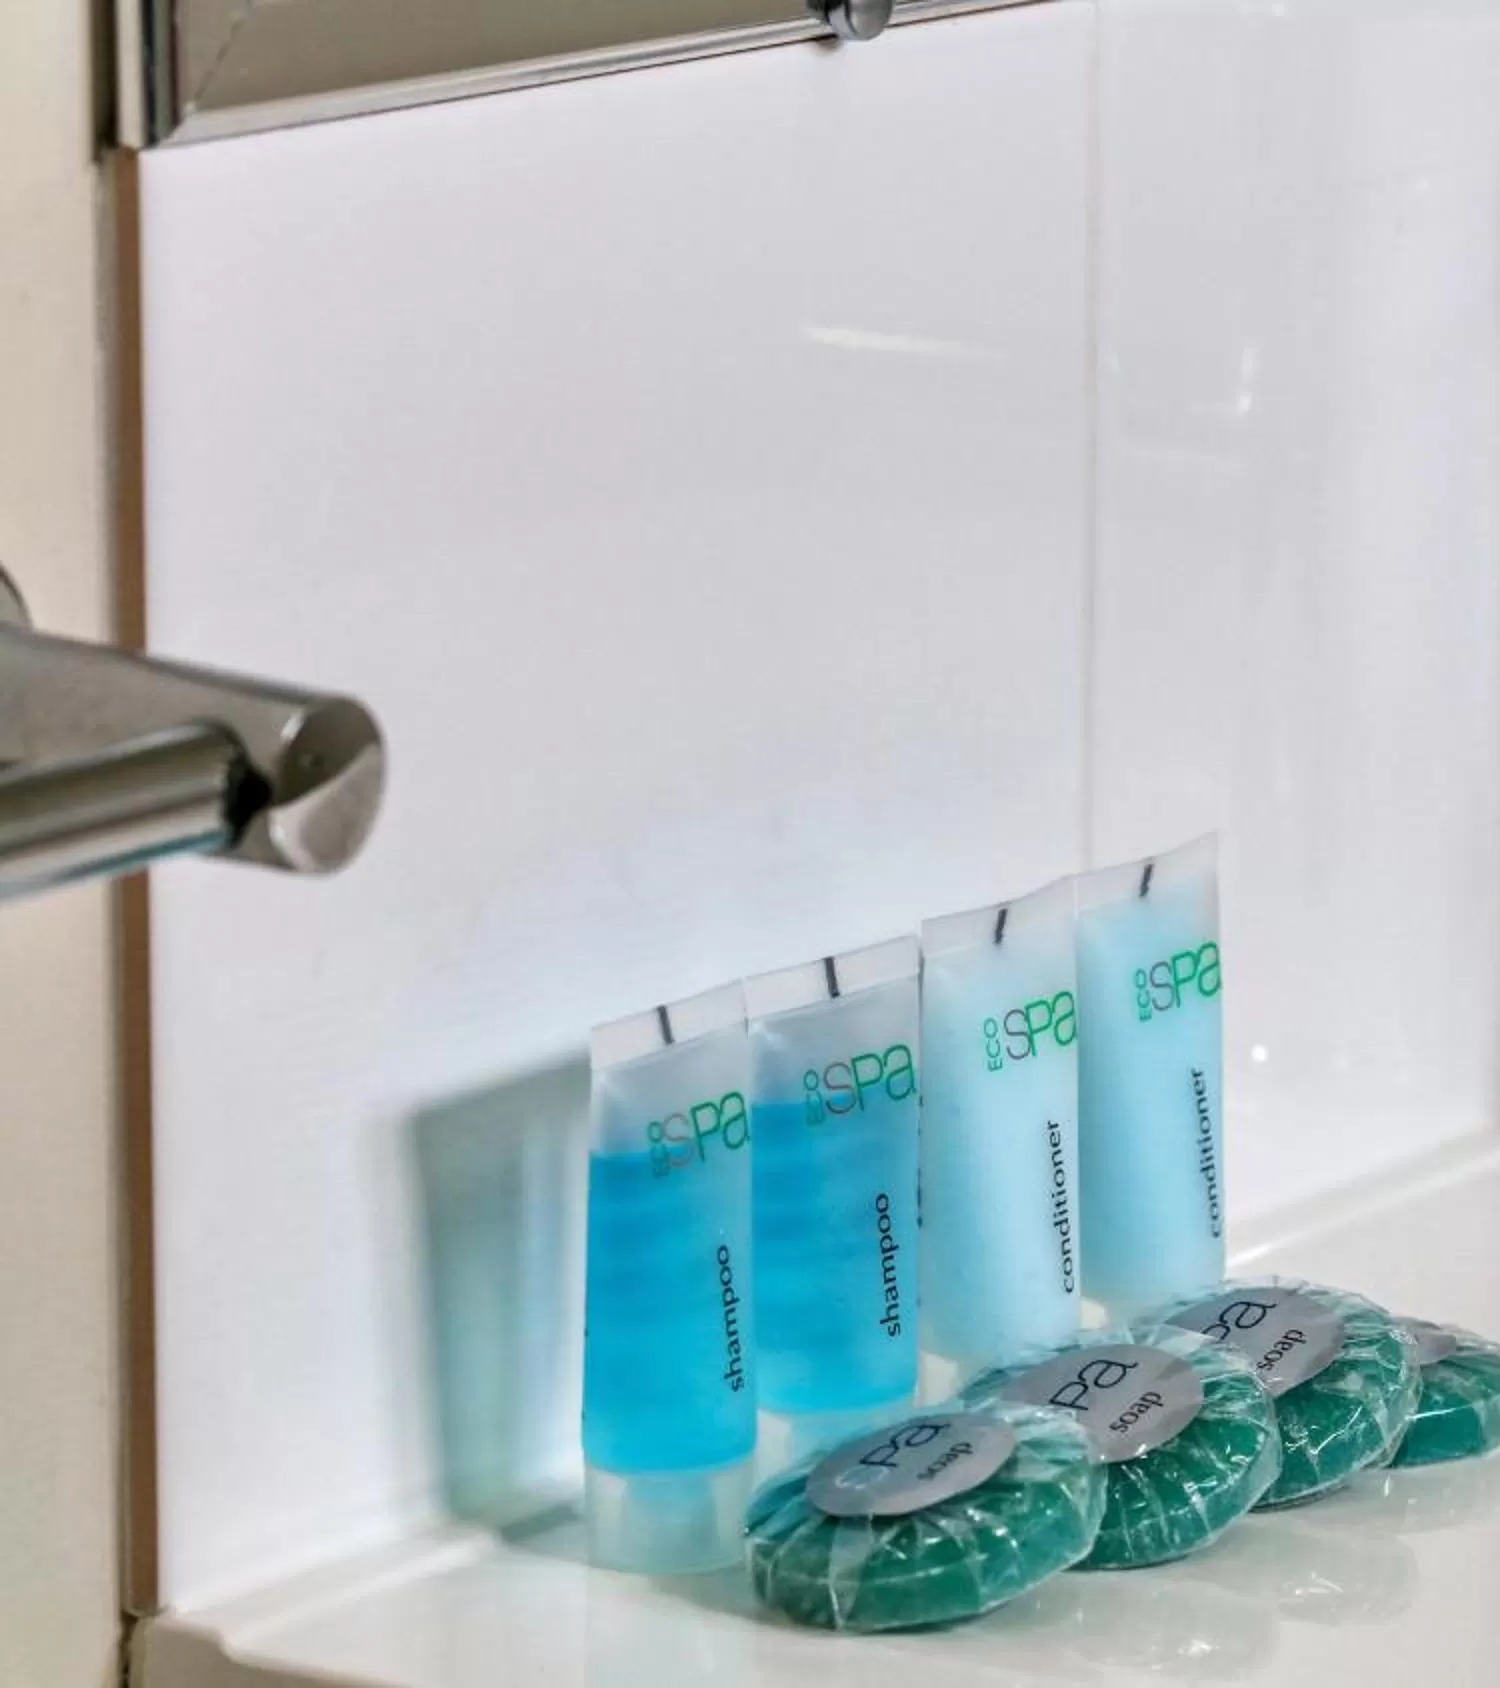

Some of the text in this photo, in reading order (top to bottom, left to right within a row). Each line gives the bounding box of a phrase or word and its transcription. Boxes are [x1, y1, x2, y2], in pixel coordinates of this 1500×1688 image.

[982, 1016, 1003, 1072] ECO
[1190, 1067, 1220, 1239] conditioner
[1047, 1120, 1074, 1294] conditioner
[875, 1193, 901, 1338] shampoo
[716, 1245, 745, 1392] shampoo
[1256, 1329, 1307, 1371] soap
[916, 1441, 974, 1481] soap
[1109, 1391, 1164, 1433] soap
